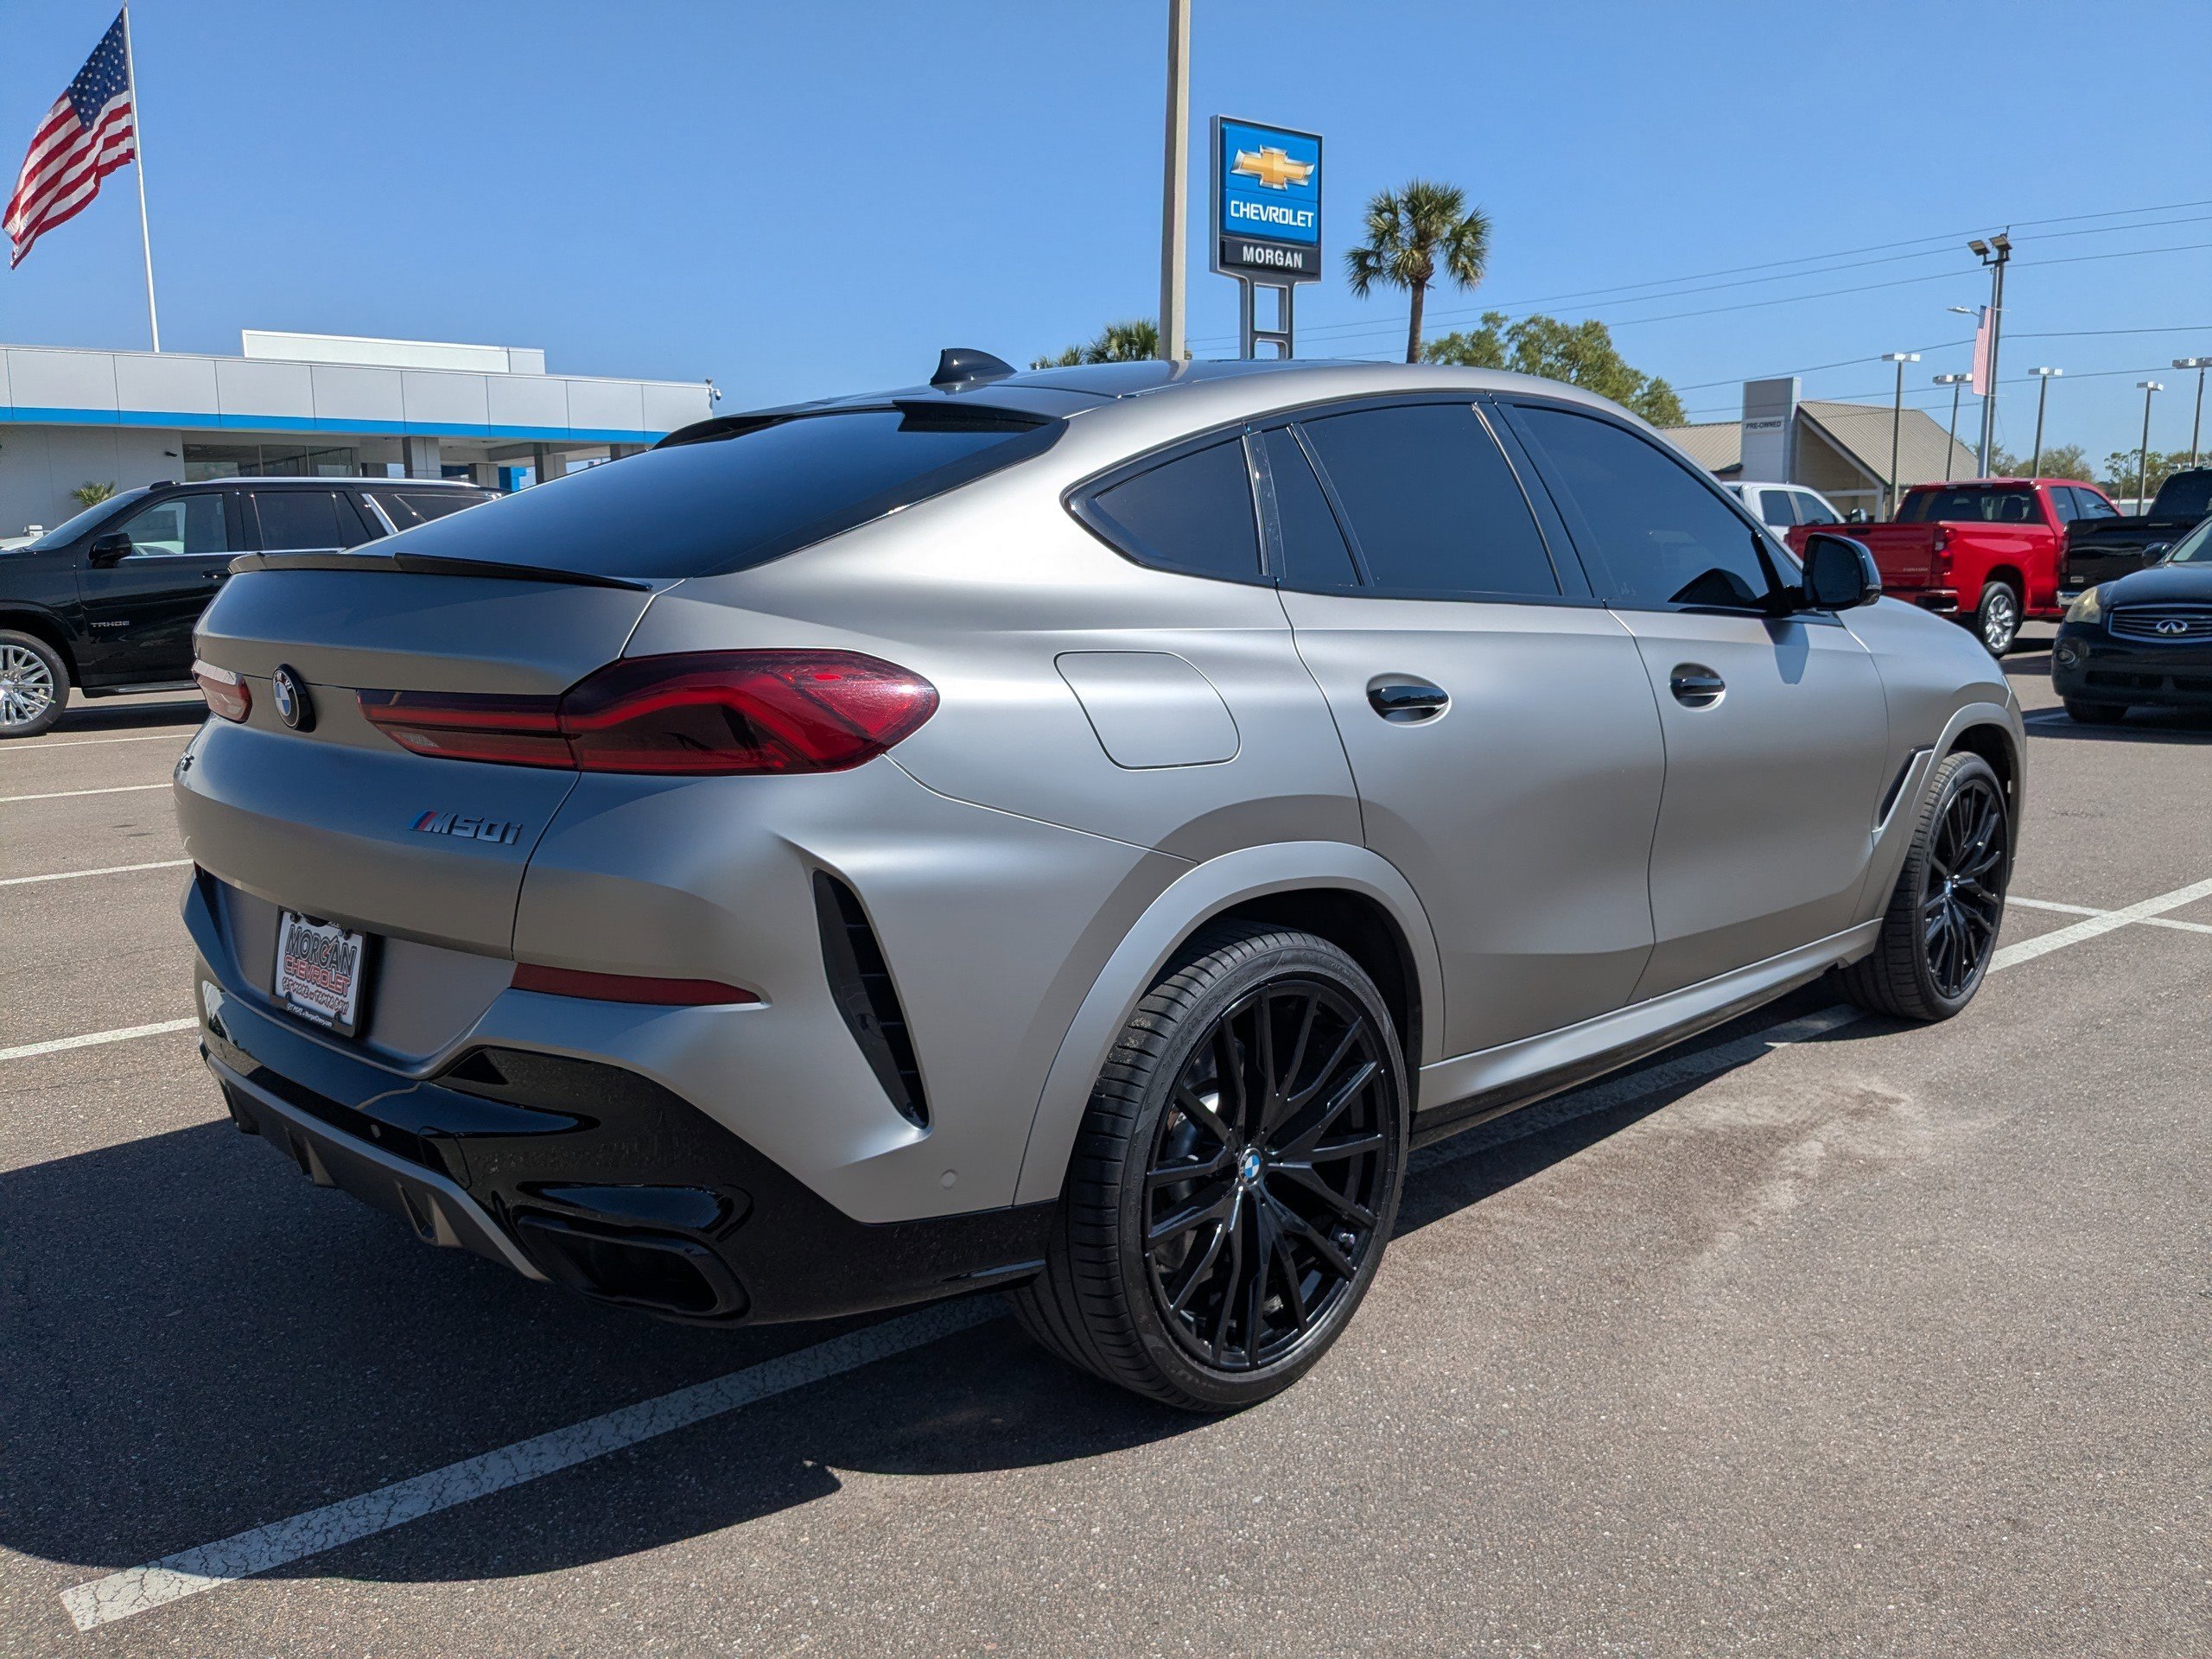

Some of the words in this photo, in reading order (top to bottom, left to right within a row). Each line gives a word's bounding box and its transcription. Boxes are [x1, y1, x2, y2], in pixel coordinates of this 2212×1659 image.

[1230, 200, 1314, 227] CHEVROLET
[1243, 245, 1302, 268] MORGAN
[1745, 421, 1781, 429] PRE-OWNED
[285, 924, 357, 978] MORGAN
[283, 954, 352, 998] CHEVROLET
